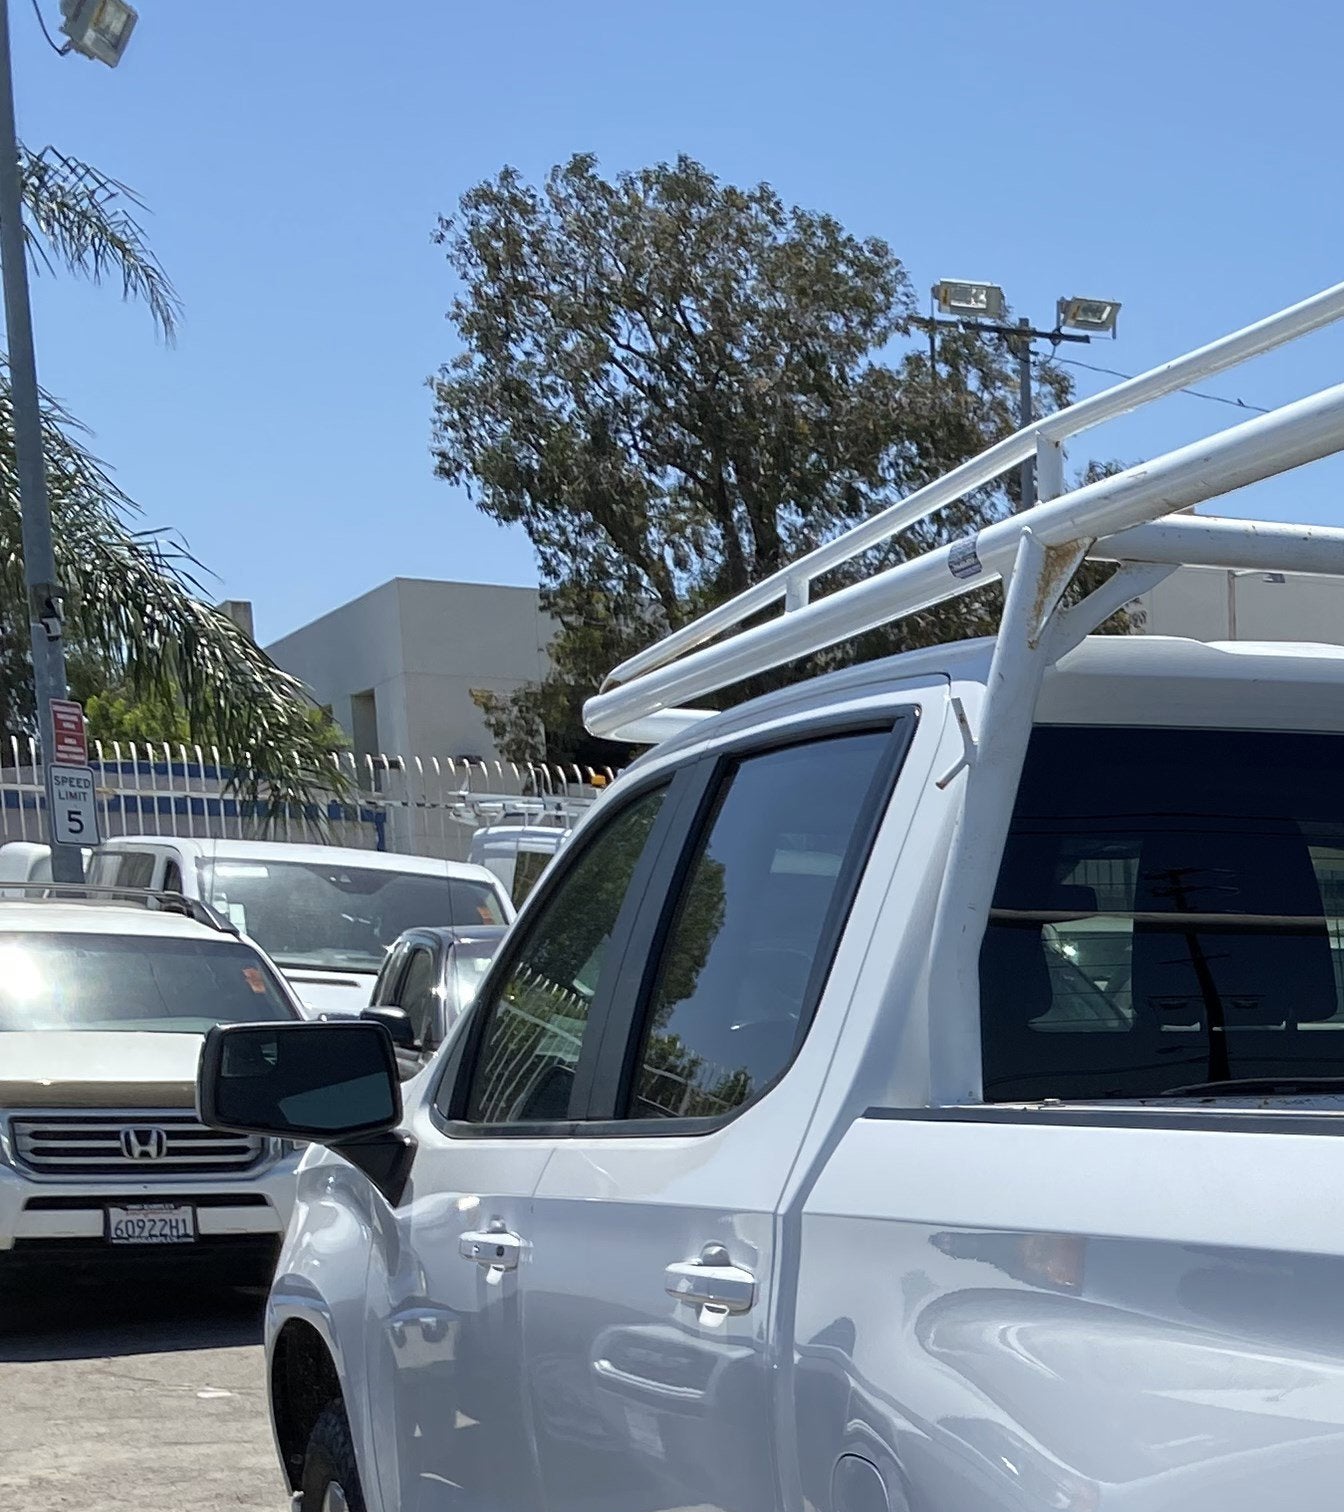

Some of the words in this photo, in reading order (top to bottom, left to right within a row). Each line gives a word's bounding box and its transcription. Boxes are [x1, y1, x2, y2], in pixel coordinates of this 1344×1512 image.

[53, 775, 91, 789] SPEED
[58, 790, 88, 802] LIMIT
[67, 809, 85, 834] 5
